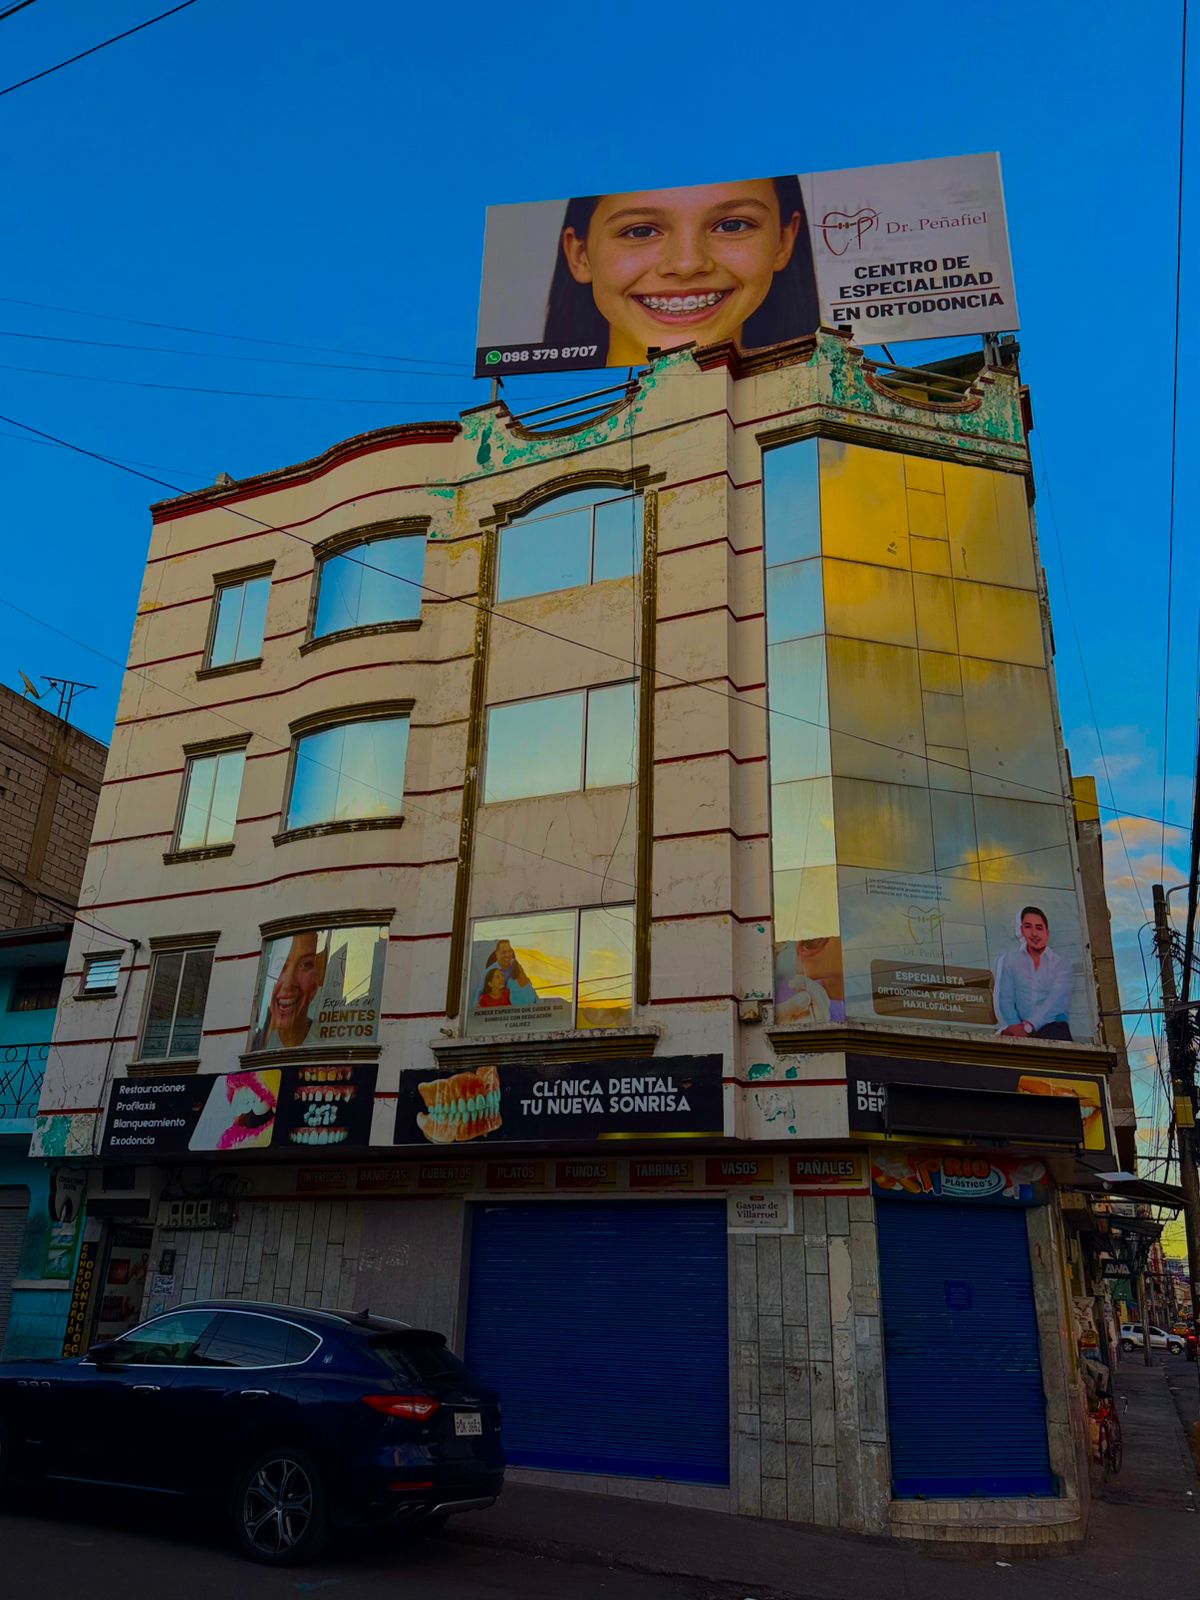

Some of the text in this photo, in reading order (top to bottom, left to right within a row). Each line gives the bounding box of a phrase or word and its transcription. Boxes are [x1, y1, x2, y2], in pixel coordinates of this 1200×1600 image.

[887, 211, 987, 234] Dr. Peñafiel
[854, 256, 970, 279] CENTRO DE
[839, 272, 993, 299] ESPECIALIDAD
[833, 293, 1005, 322] EN ORTODONCIA
[502, 345, 597, 363] 098 379 8707
[895, 971, 965, 986] ESPECIALISTA
[877, 986, 930, 998] ORTODONCIA
[939, 992, 985, 1003] ORTOPEDIA
[903, 1000, 964, 1013] MAXILOFACIAL
[319, 1009, 376, 1023] DIENTES
[320, 1025, 374, 1038] RECTOS
[119, 1083, 186, 1095] Restauraciones
[608, 1076, 678, 1095] DENTAL
[116, 1101, 157, 1112] Profilaxis
[520, 1095, 691, 1115] TU NUEVA SONRISA
[113, 1117, 187, 1131] Blanqueamiento
[109, 1136, 156, 1146] Exodoncia
[422, 1167, 472, 1180] CUBIERTOS
[497, 1166, 535, 1179] PLATOS
[565, 1165, 608, 1177] FUNDAS
[635, 1163, 689, 1177] TARRINAS
[721, 1161, 758, 1175] VASOS
[797, 1159, 855, 1175] PAÑALES
[943, 1156, 991, 1179] RIO
[360, 1168, 408, 1181] BANDEJAS
[736, 1201, 778, 1212] Gaspar de
[737, 1210, 779, 1219] Villarroel
